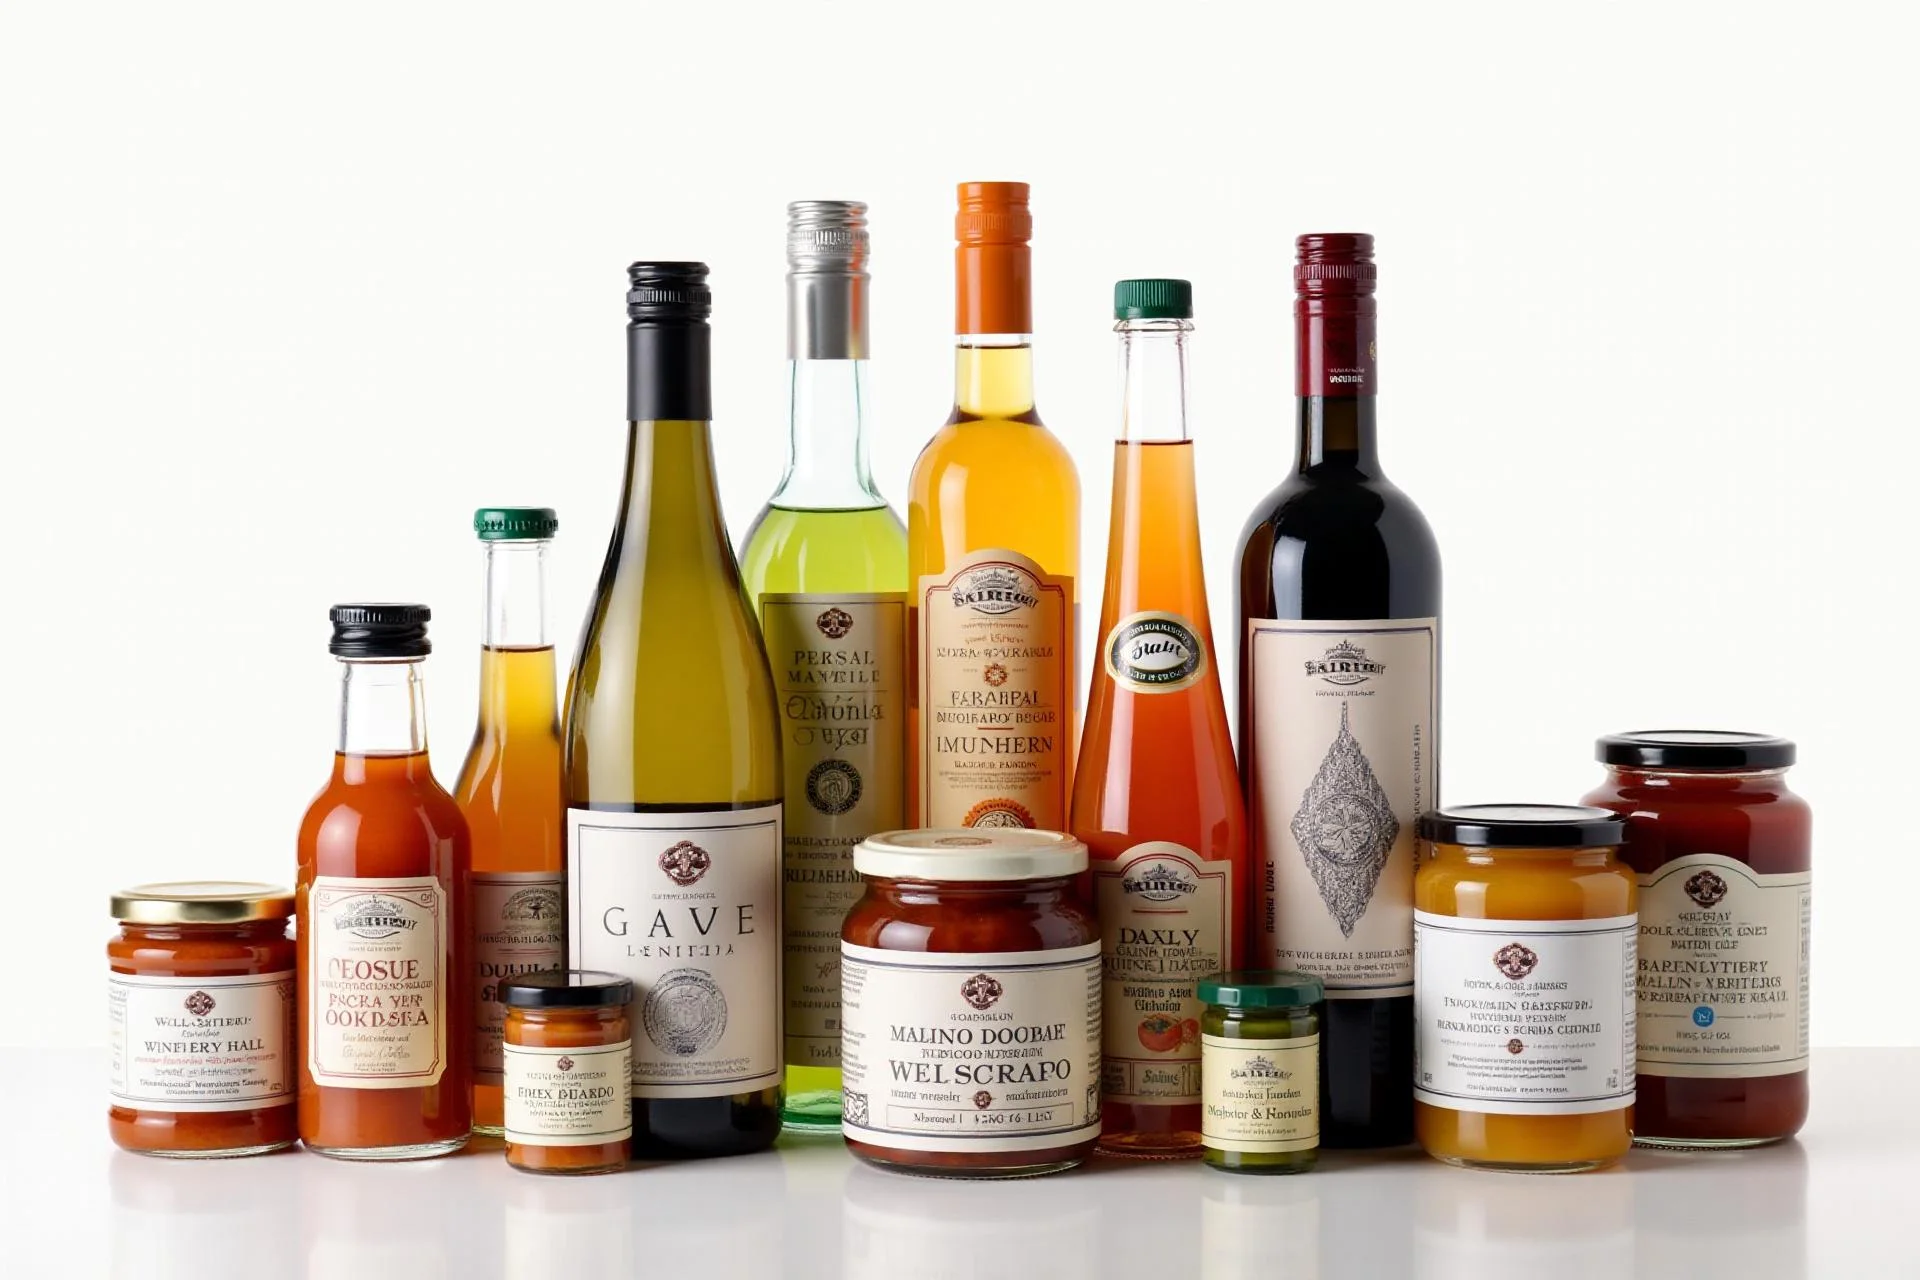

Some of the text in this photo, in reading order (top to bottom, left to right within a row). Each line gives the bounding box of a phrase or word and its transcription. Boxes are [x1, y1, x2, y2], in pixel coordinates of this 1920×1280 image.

[603, 904, 755, 938] GAVE
[1119, 927, 1200, 946] DAXLY
[890, 1025, 973, 1045] MALINO
[227, 1038, 265, 1052] HALL
[1251, 1107, 1262, 1119] &
